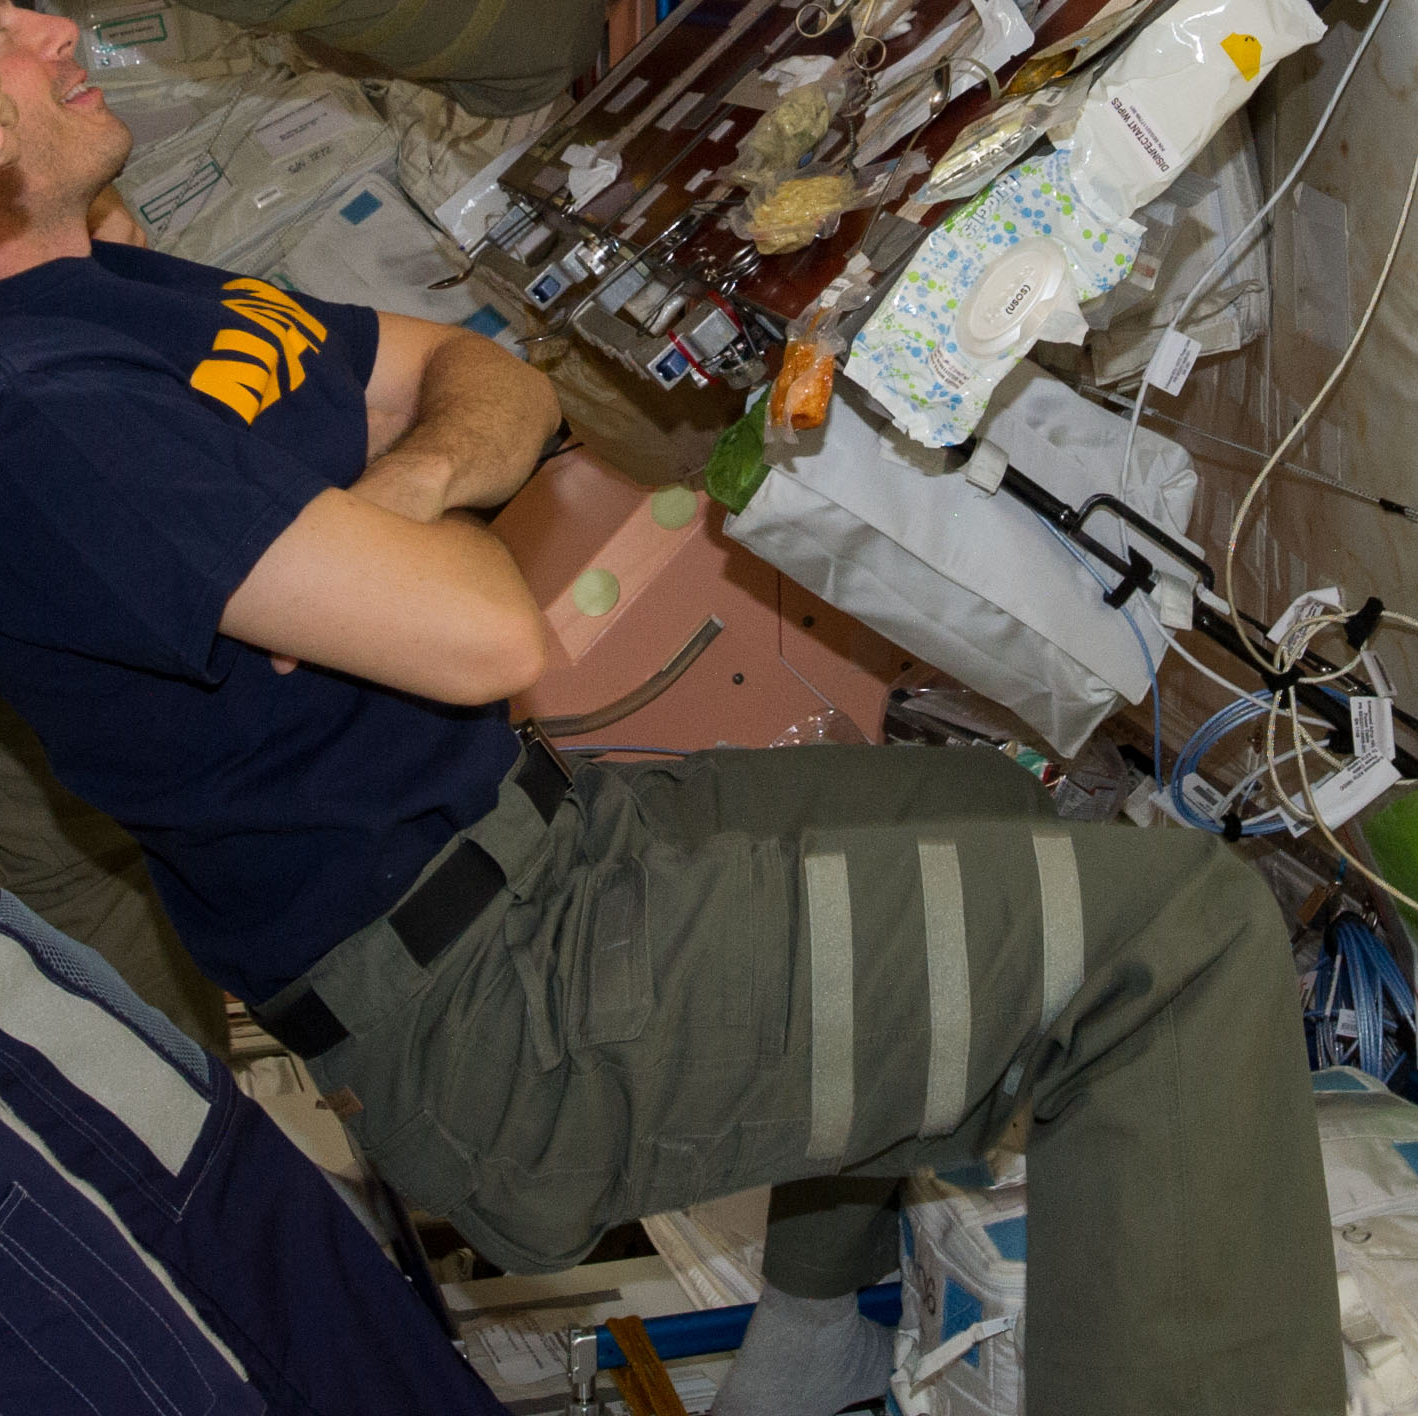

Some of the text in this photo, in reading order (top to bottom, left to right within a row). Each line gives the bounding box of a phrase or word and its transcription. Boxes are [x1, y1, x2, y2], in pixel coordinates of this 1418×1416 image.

[1111, 97, 1170, 173] DISINFECTANT WIPES
[1005, 284, 1032, 315] (USOS)
